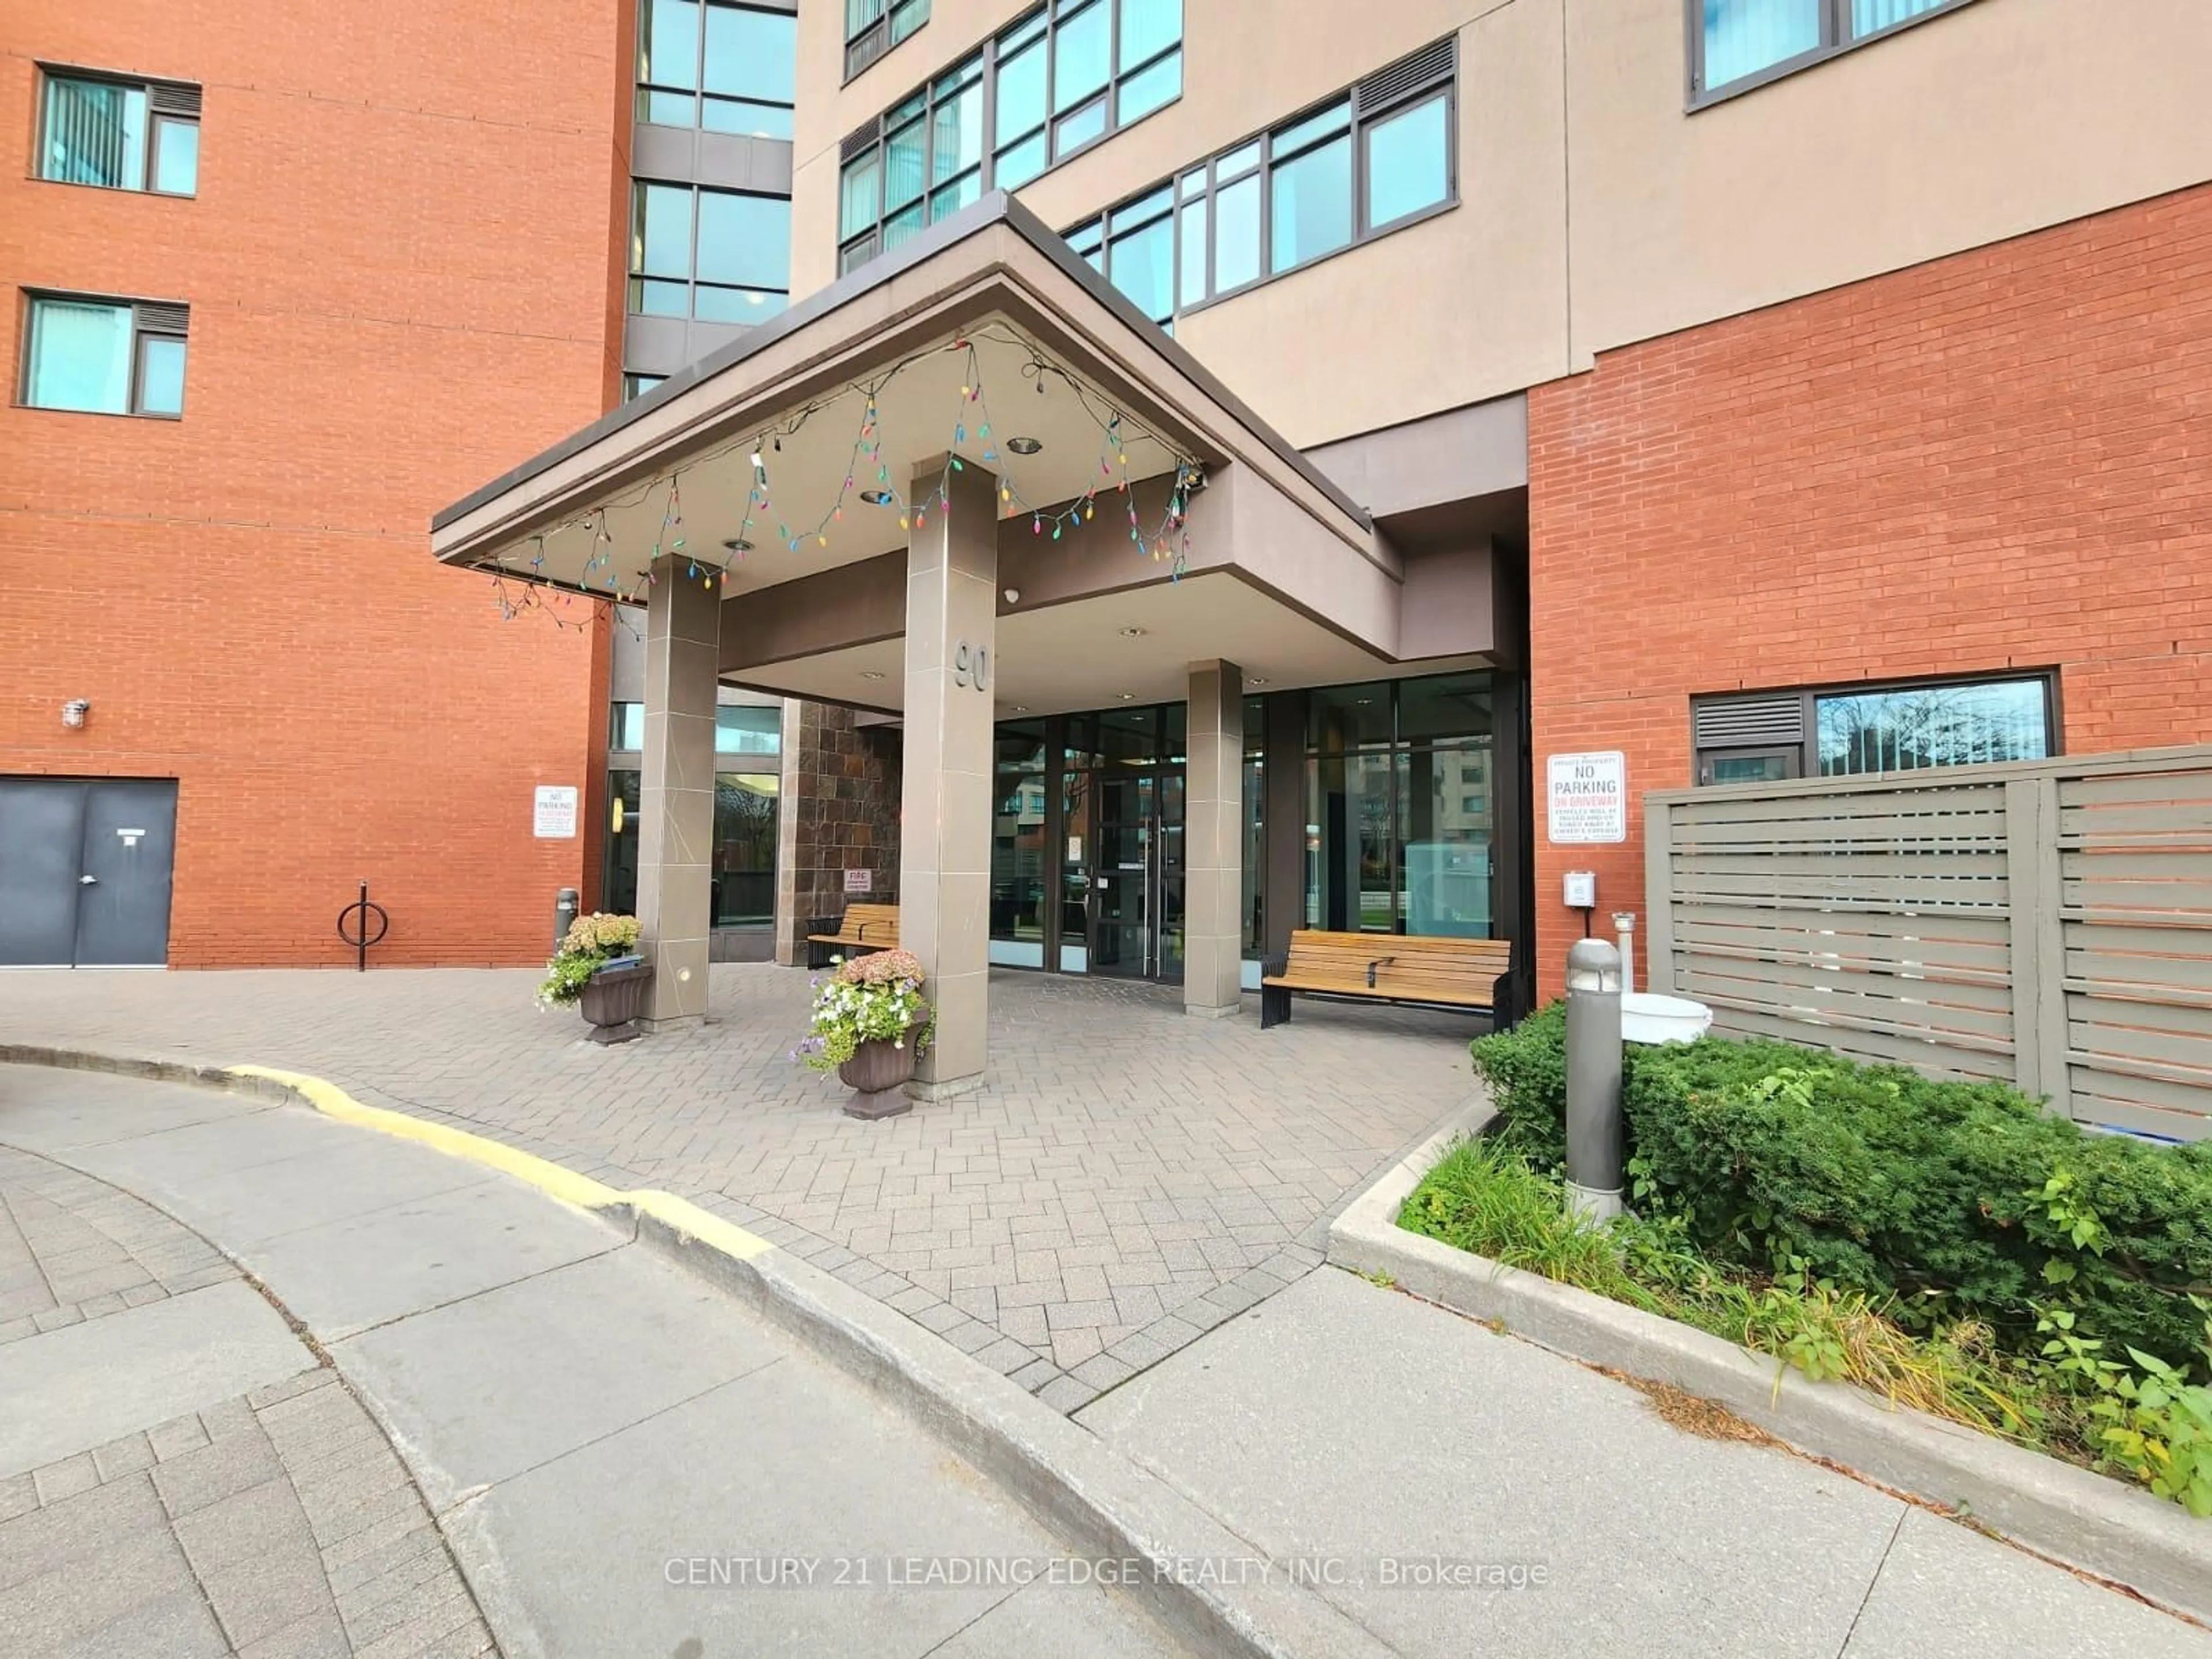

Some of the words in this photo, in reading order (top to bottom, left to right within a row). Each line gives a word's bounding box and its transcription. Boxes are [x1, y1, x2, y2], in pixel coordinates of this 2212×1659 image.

[1575, 766, 1594, 779] NO
[1555, 780, 1616, 794] PARKING
[1570, 796, 1618, 806] DRIVEWAY
